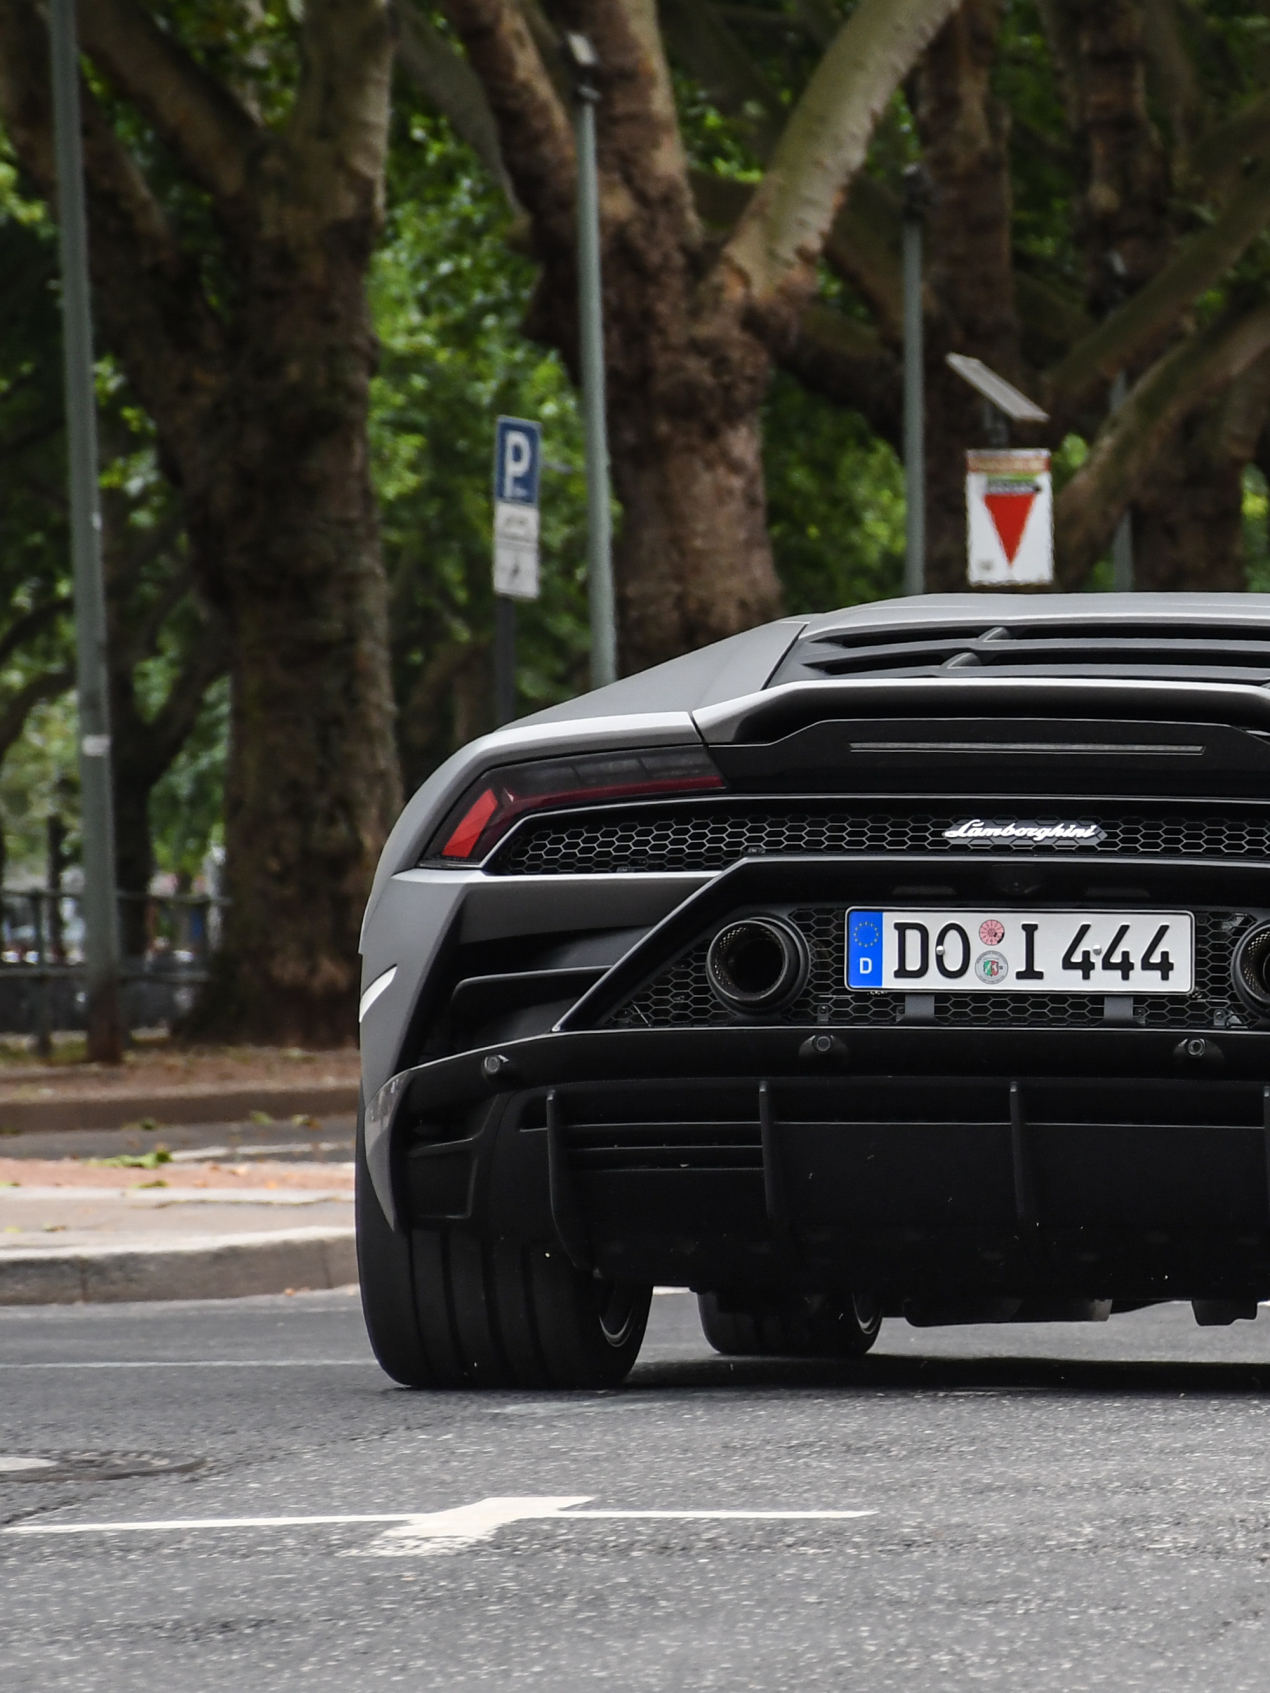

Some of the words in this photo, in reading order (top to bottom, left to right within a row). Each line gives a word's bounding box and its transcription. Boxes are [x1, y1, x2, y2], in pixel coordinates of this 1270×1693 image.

[504, 430, 531, 498] P
[944, 819, 1098, 841] Lamborghini
[859, 957, 873, 974] D
[893, 921, 971, 979] DO
[1015, 923, 1044, 980] I
[1061, 923, 1175, 980] 444
